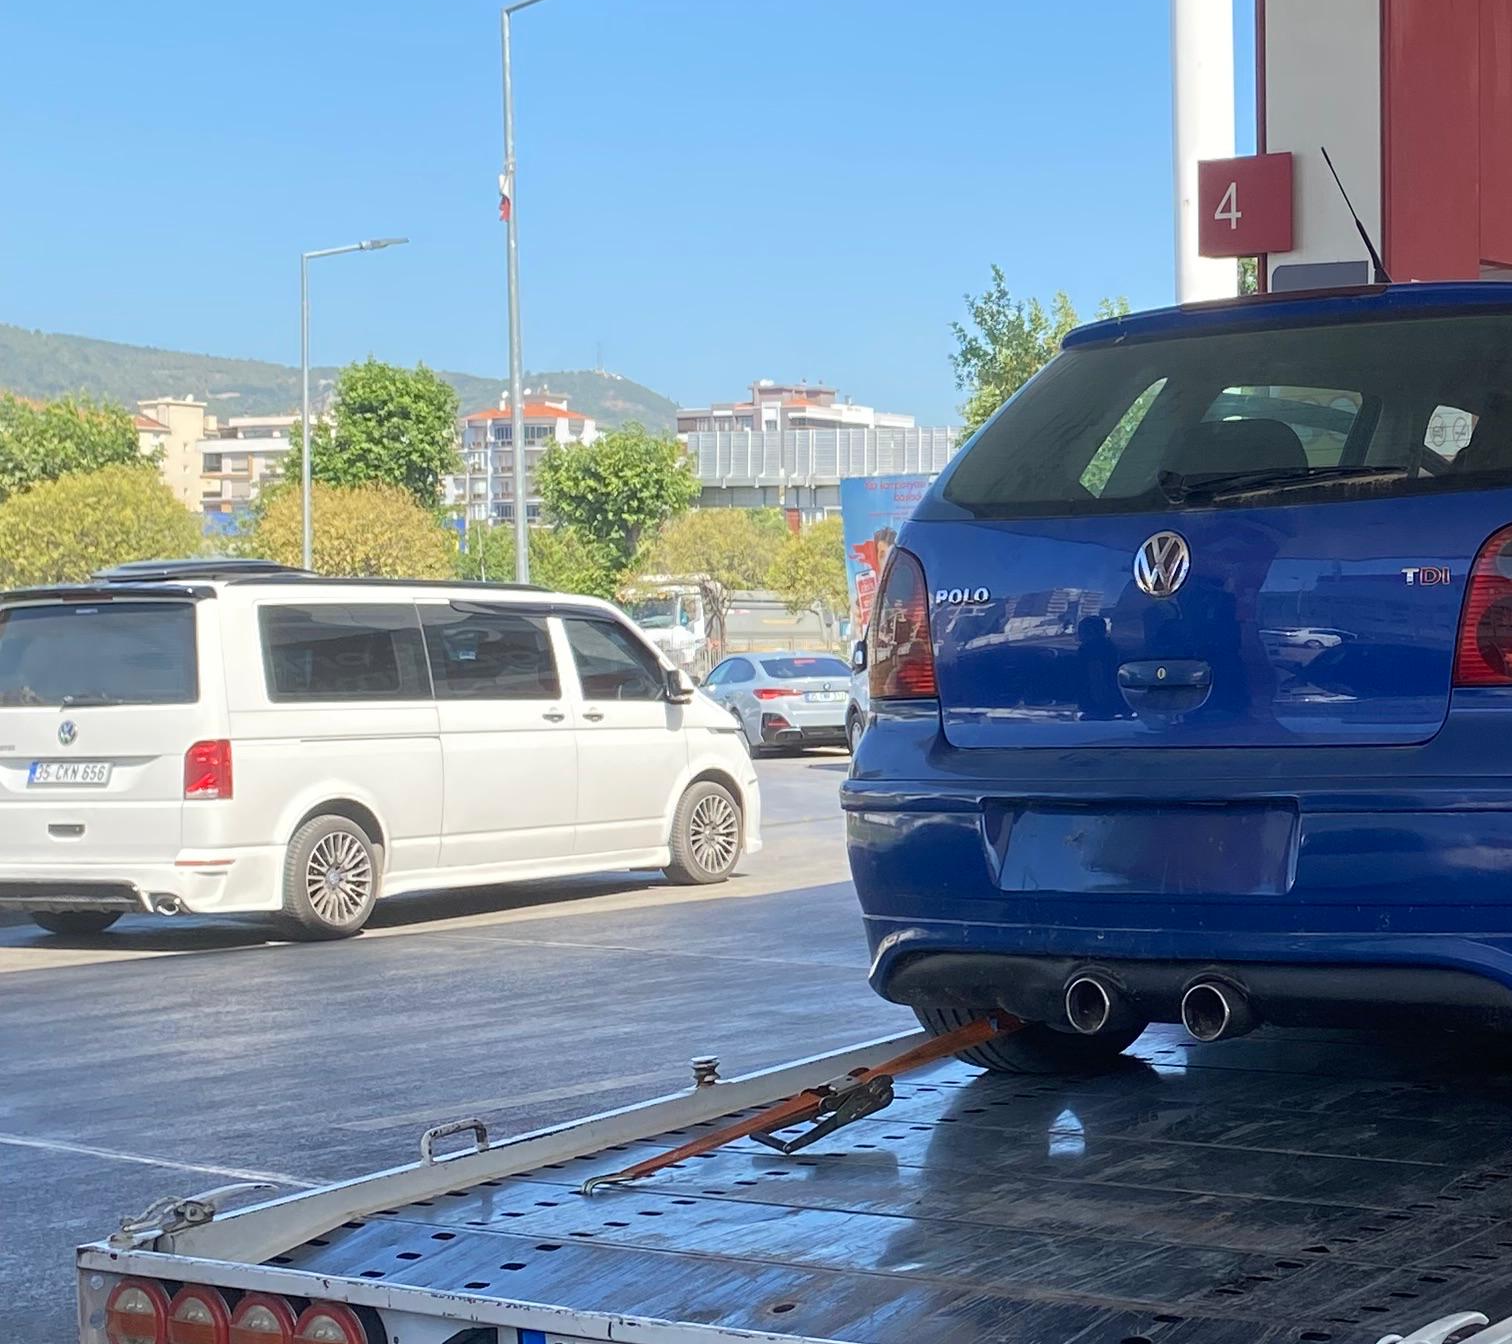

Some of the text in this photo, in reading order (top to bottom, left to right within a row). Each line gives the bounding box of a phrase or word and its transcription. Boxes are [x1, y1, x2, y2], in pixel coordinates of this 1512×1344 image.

[1214, 182, 1242, 230] 4
[1400, 566, 1450, 586] TDI
[935, 587, 990, 605] POLO
[35, 763, 106, 781] 35 CKN 656
